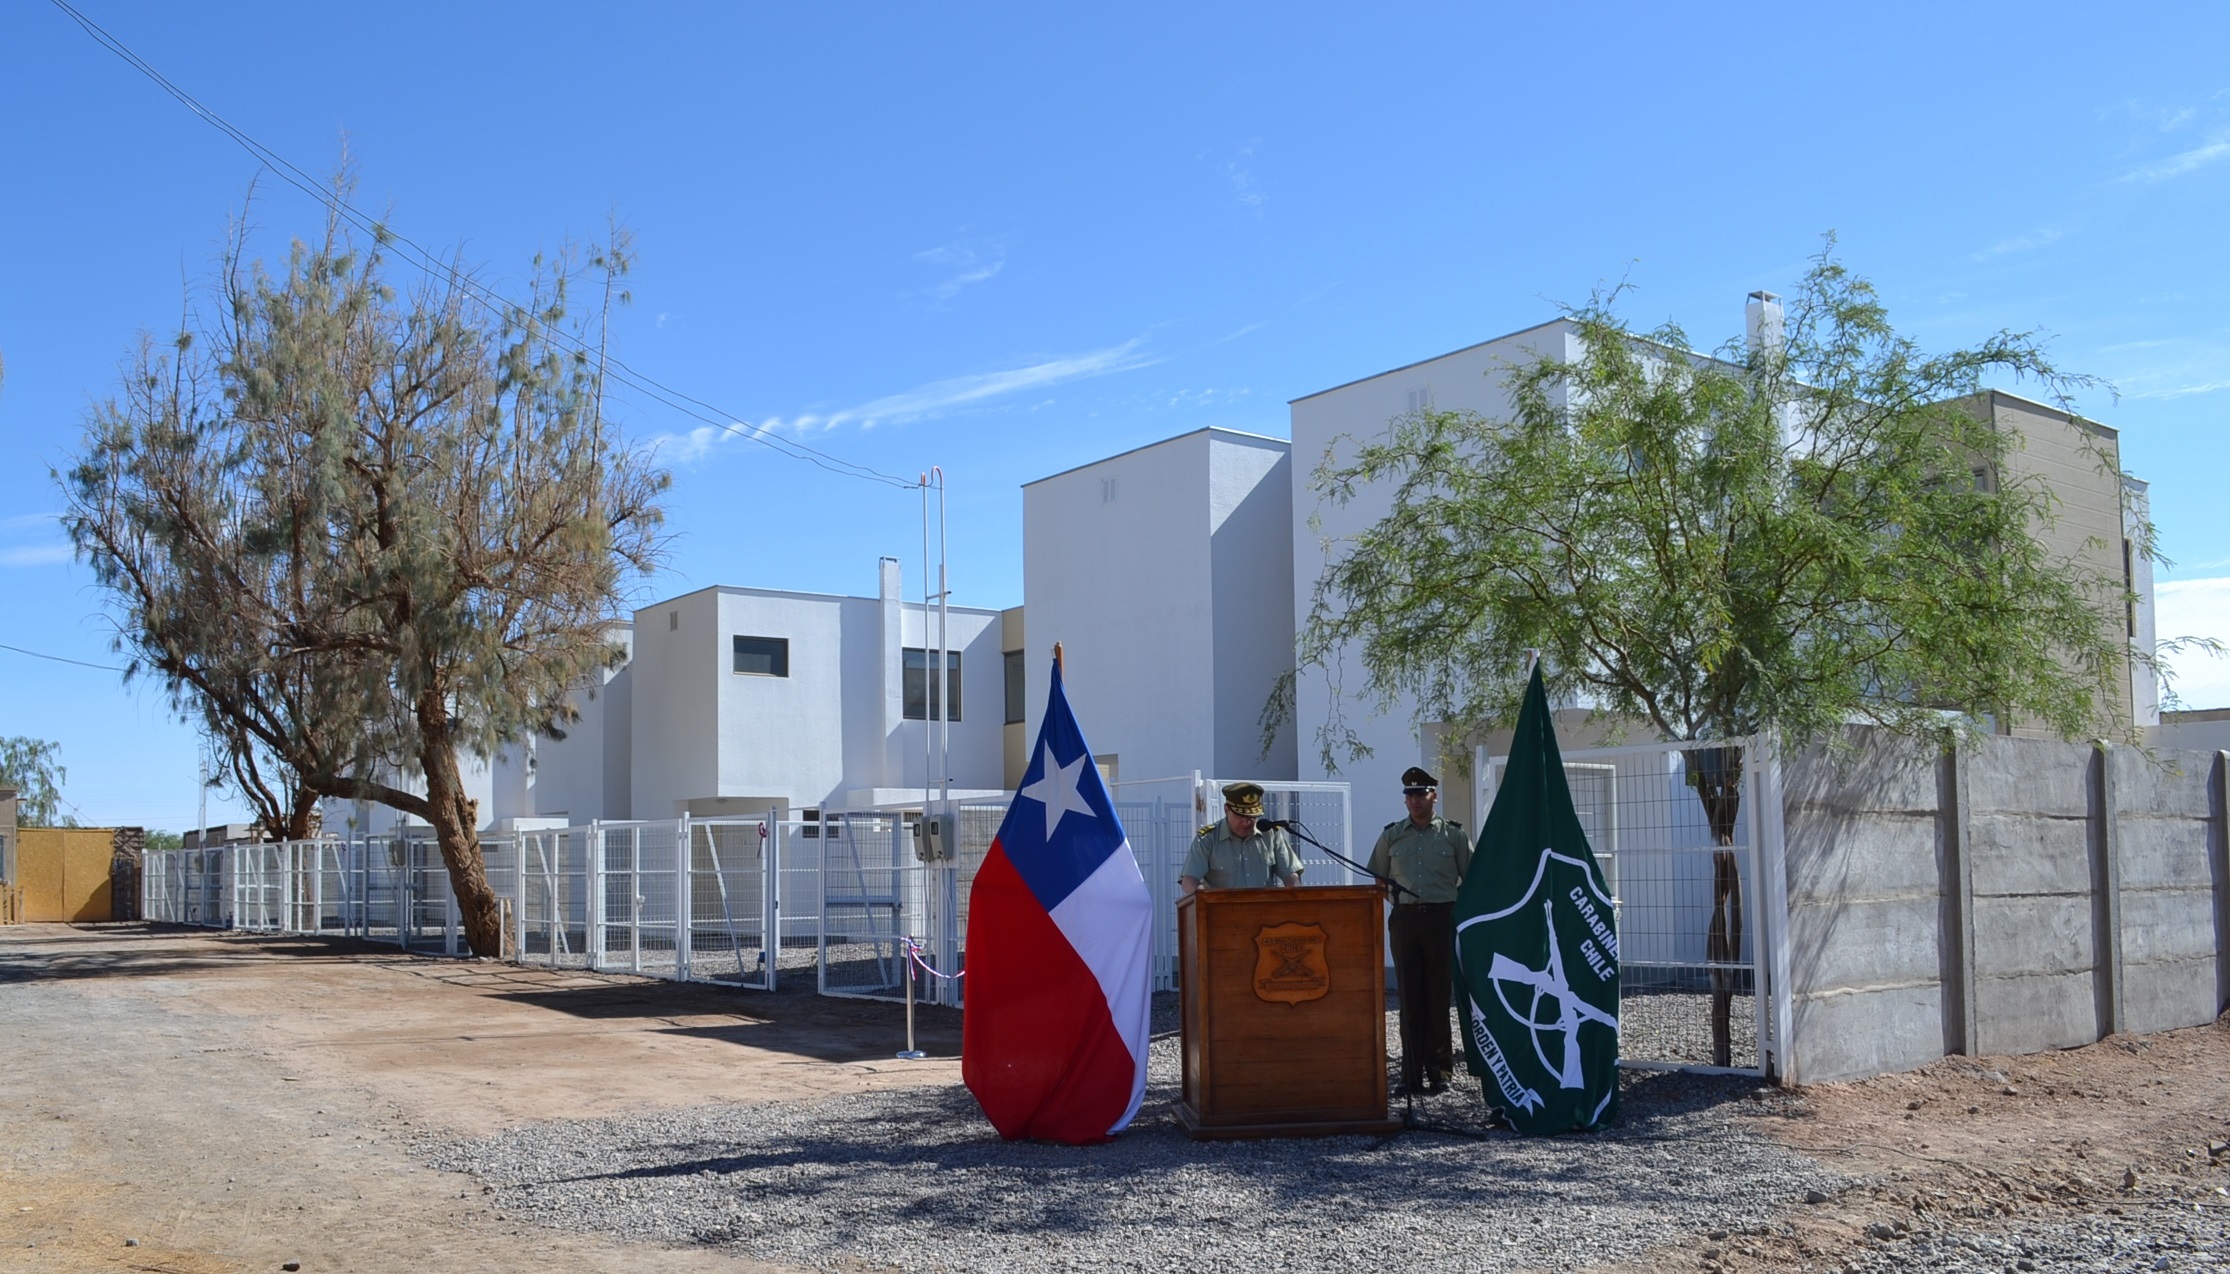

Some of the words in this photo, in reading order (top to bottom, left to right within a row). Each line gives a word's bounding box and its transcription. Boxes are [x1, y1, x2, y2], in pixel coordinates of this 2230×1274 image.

[1569, 886, 1618, 961] CARABINE
[1580, 939, 1615, 982] CHILE
[1472, 1019, 1499, 1060] ORDEN
[1491, 1055, 1503, 1068] Y
[1496, 1063, 1526, 1104] PATRIA
